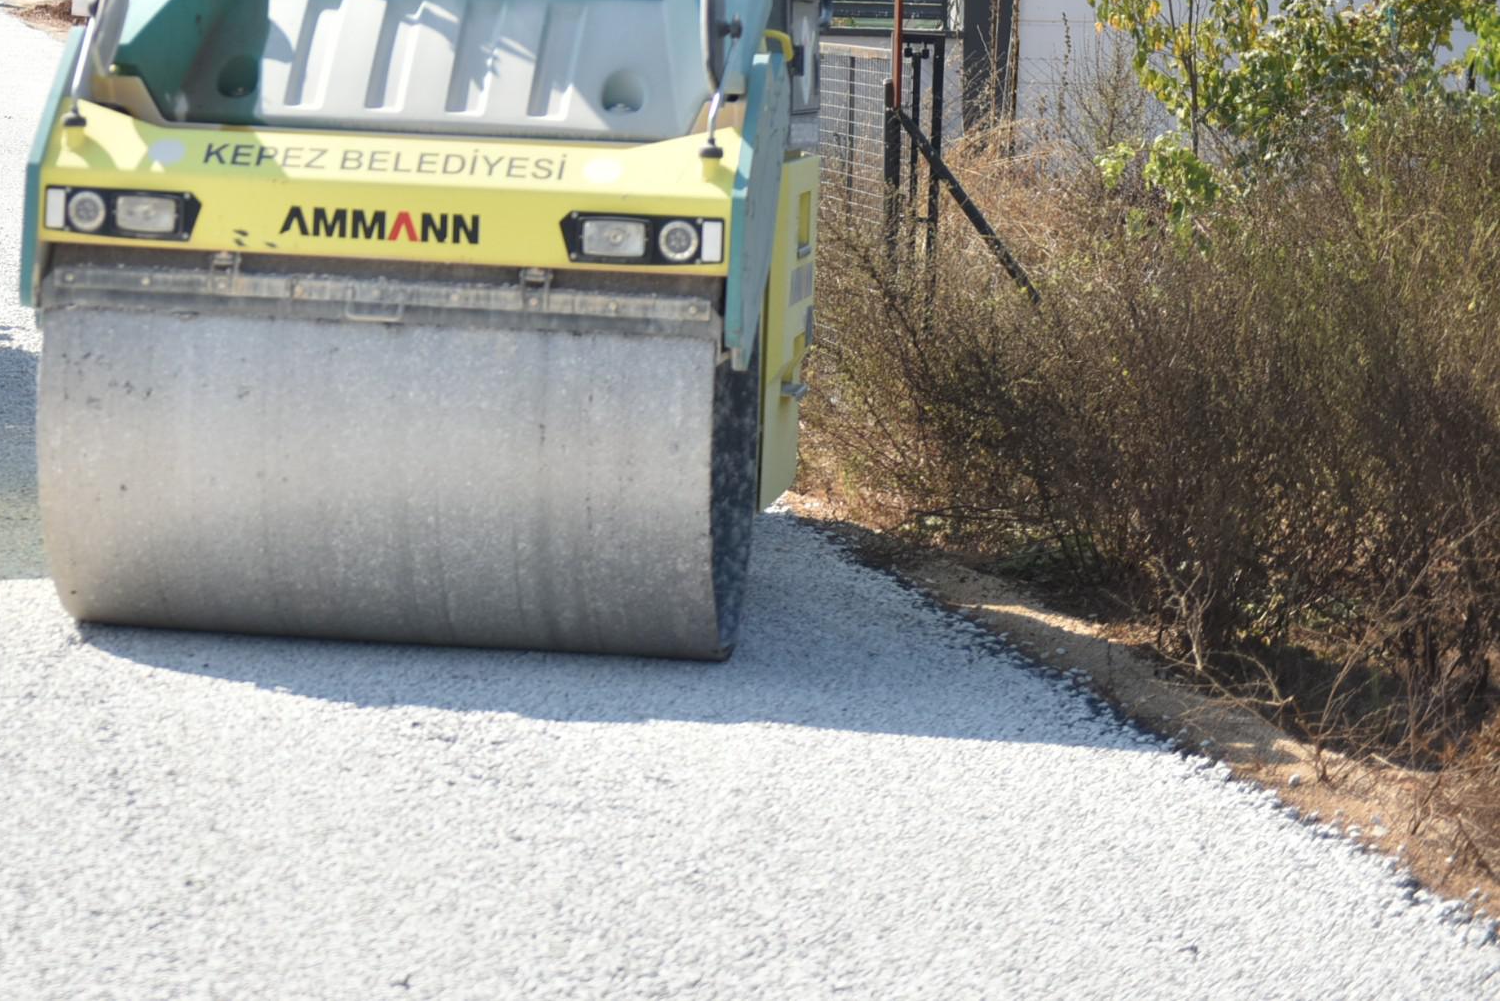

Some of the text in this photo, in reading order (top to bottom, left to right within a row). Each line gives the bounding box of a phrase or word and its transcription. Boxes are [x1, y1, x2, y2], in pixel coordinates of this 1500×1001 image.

[203, 141, 569, 182] KEPEZ BELEDİYESİ
[279, 204, 481, 245] AMMANN
